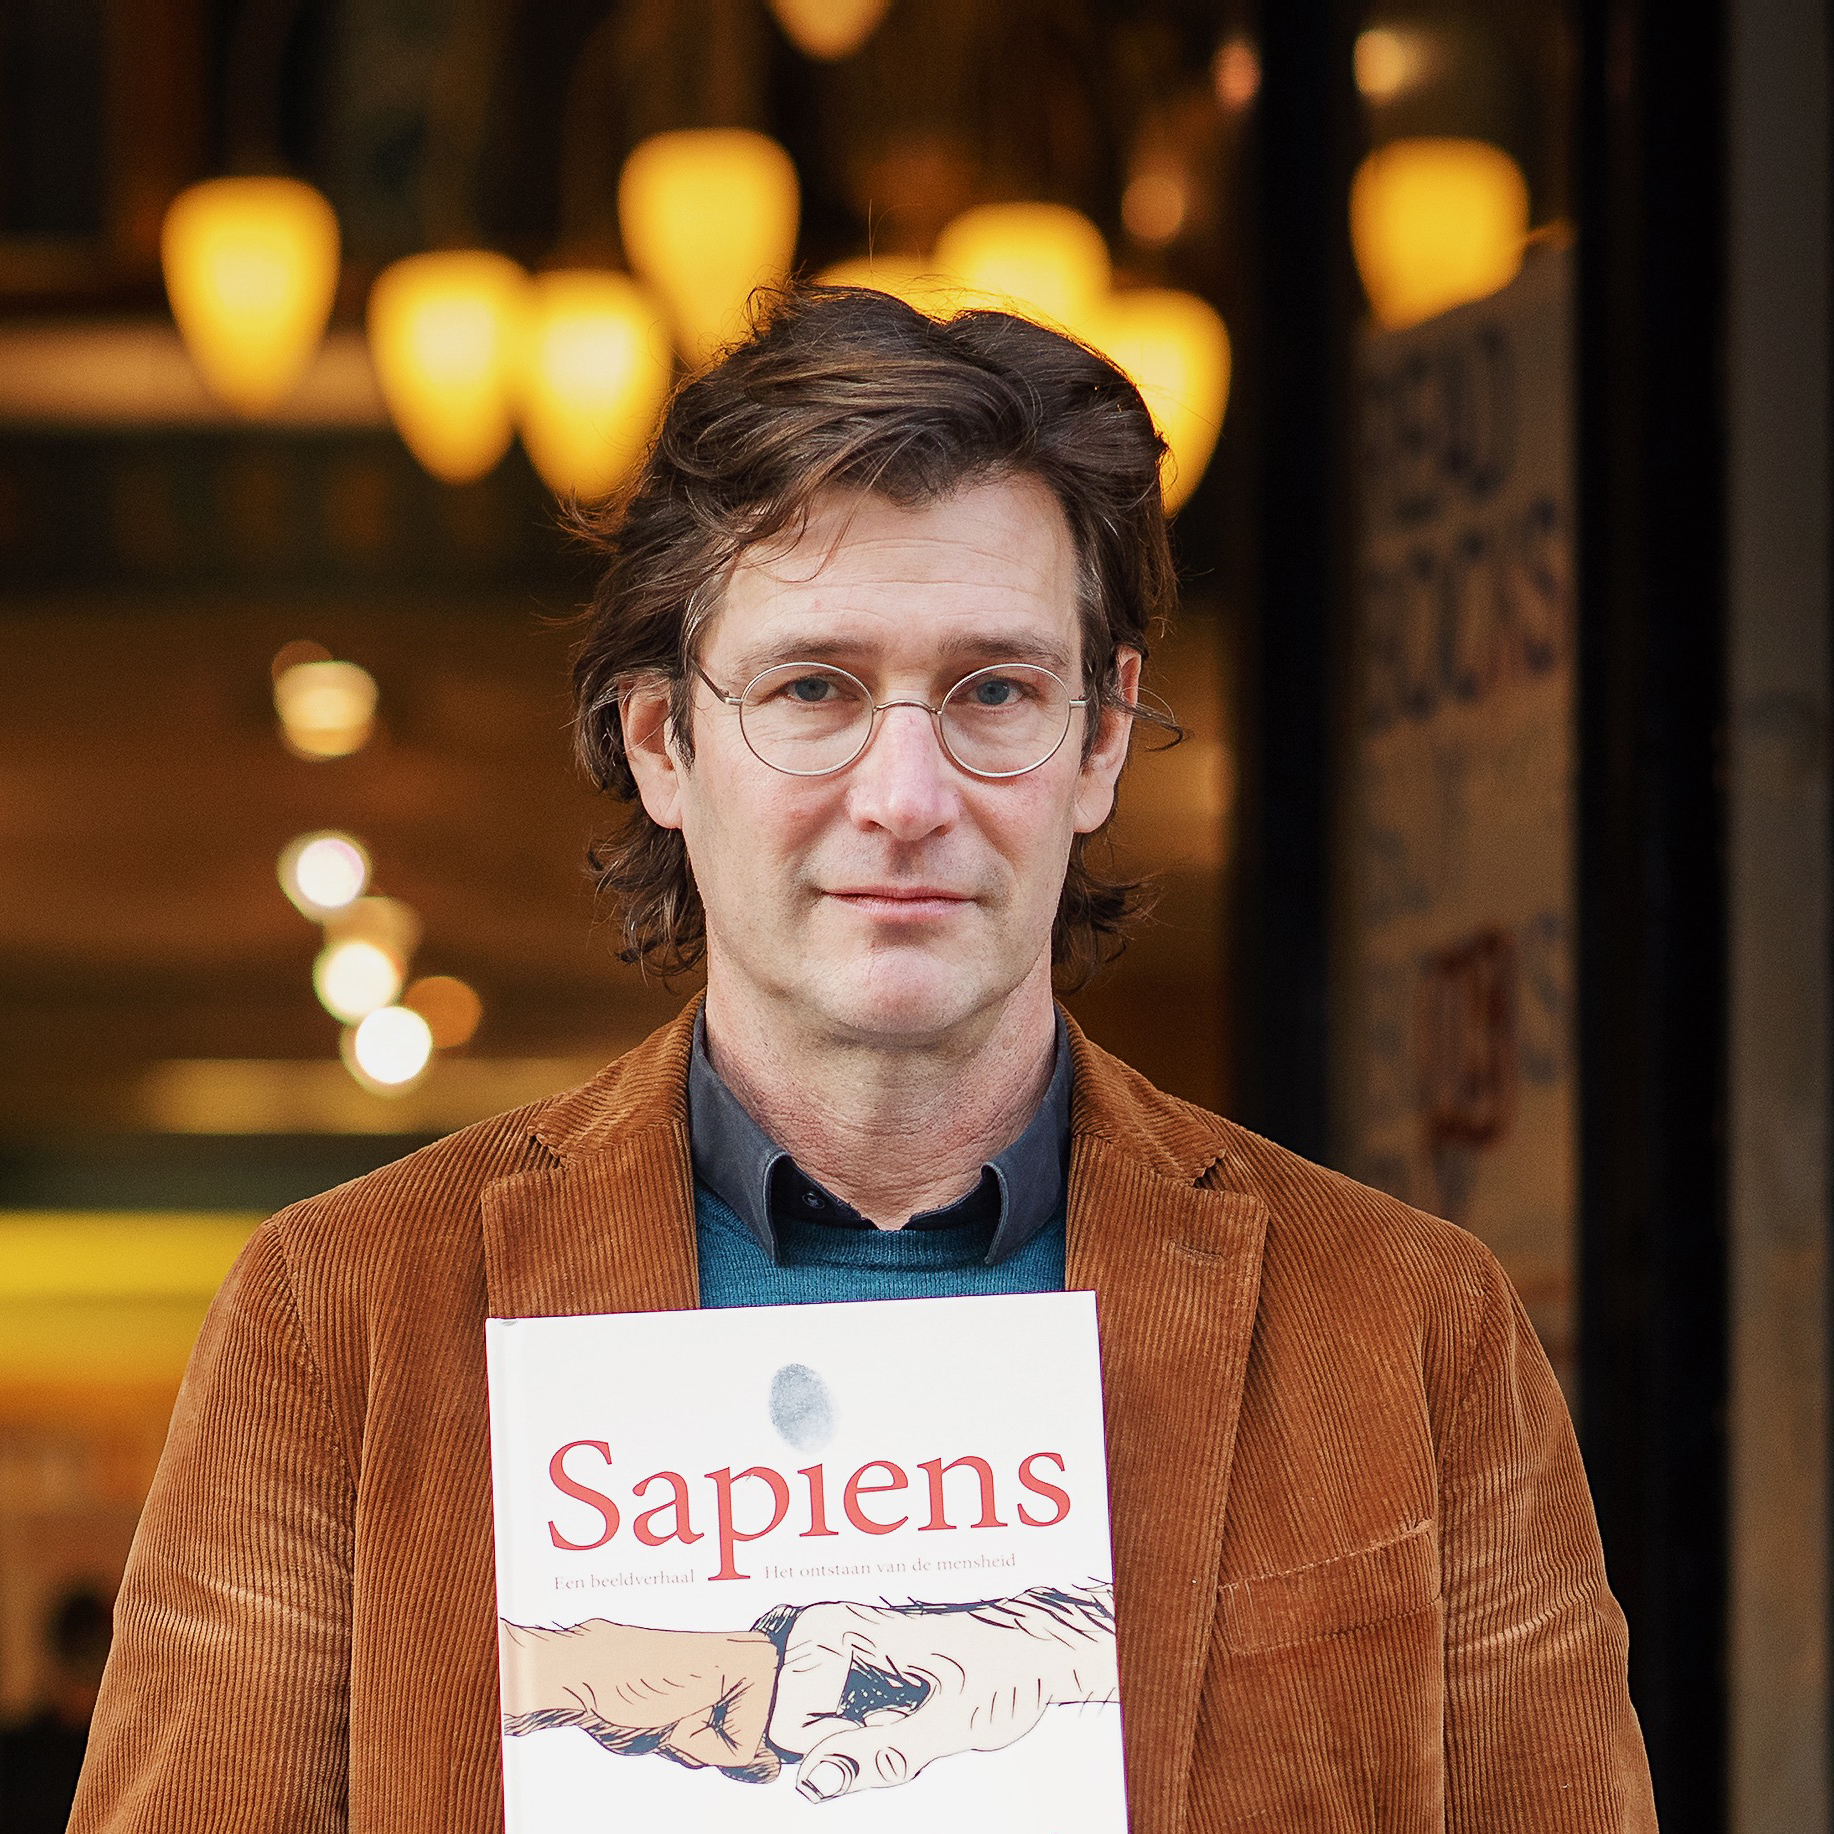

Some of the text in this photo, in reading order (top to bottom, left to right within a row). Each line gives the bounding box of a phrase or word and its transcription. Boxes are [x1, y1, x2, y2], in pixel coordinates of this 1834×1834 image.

[548, 1440, 1071, 1581] Sapiens
[553, 1568, 696, 1591] Een beeldverhaal
[764, 1552, 1017, 1580] Het ontstaan van de mensheid
